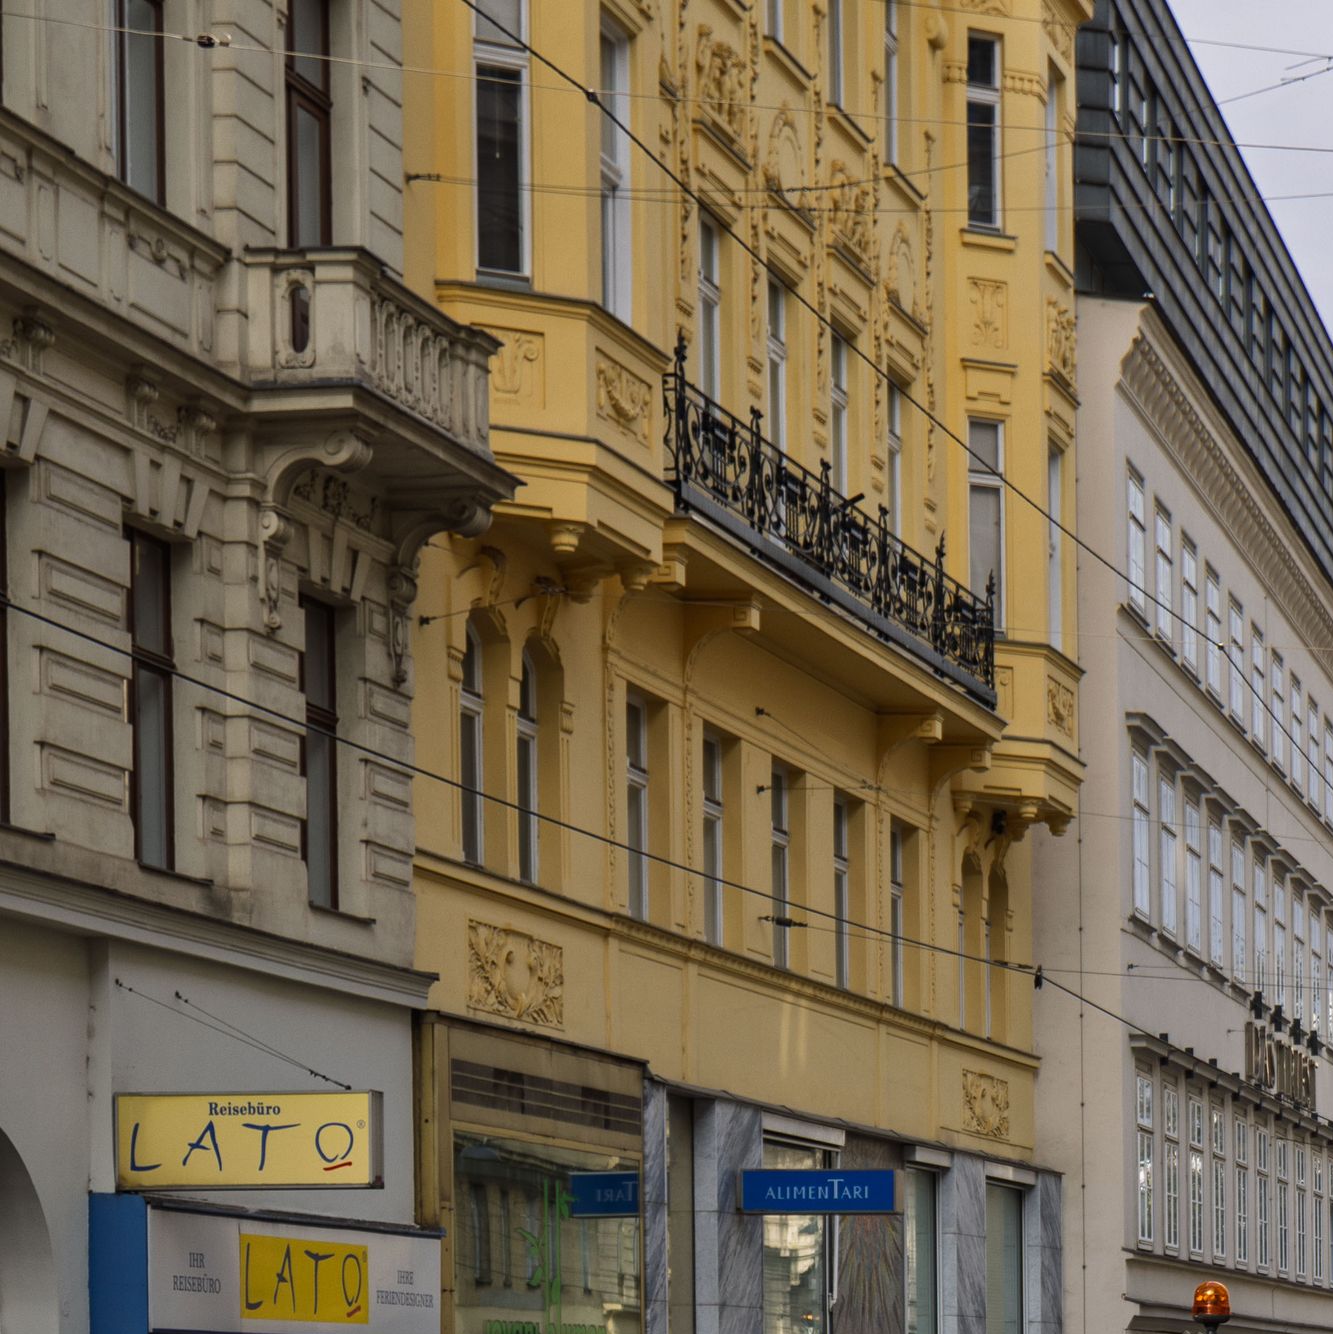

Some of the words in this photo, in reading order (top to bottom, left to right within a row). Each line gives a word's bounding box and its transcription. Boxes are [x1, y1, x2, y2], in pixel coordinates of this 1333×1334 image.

[208, 1102, 281, 1116] Reisebüro
[130, 1120, 354, 1172] LATO
[765, 1178, 869, 1199] ALIMENTARI
[189, 1252, 205, 1268] IHR
[173, 1274, 221, 1294] REISEBÜRO
[245, 1243, 362, 1315] LATO
[397, 1270, 414, 1285] IHRE
[376, 1290, 434, 1308] FERIENDESIGNER
